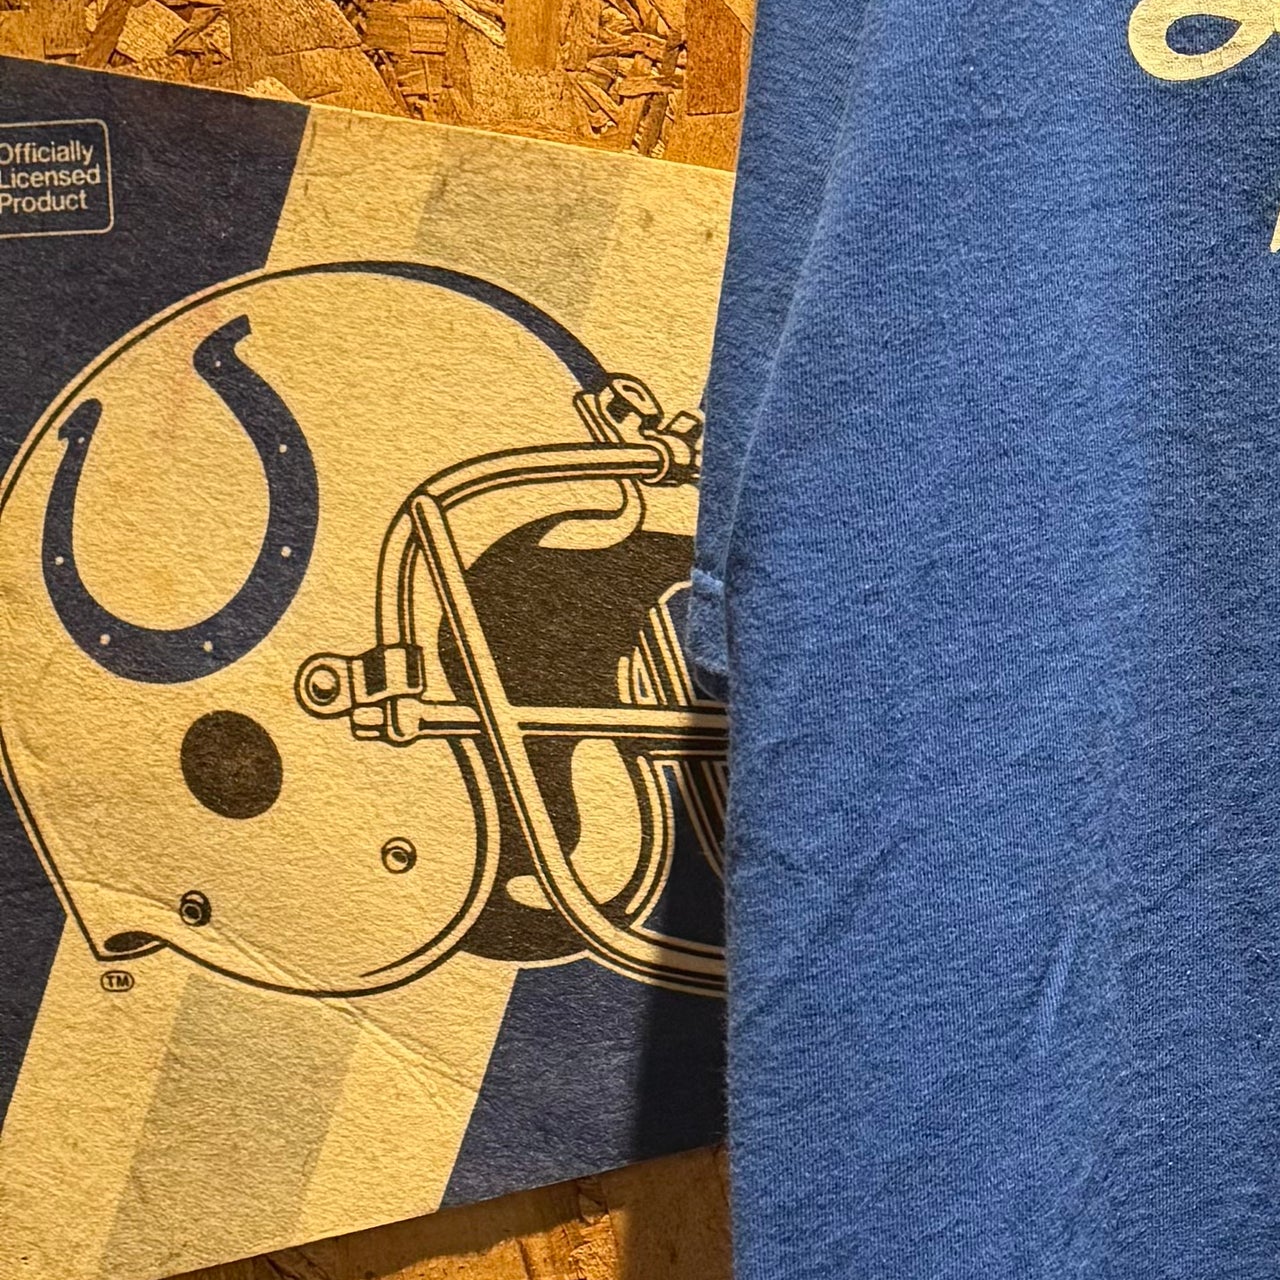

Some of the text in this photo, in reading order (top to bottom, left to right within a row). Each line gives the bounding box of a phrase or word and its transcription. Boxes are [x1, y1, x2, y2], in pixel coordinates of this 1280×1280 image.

[0, 140, 94, 166] Officially
[0, 163, 101, 189] Licensed
[0, 189, 88, 214] Product
